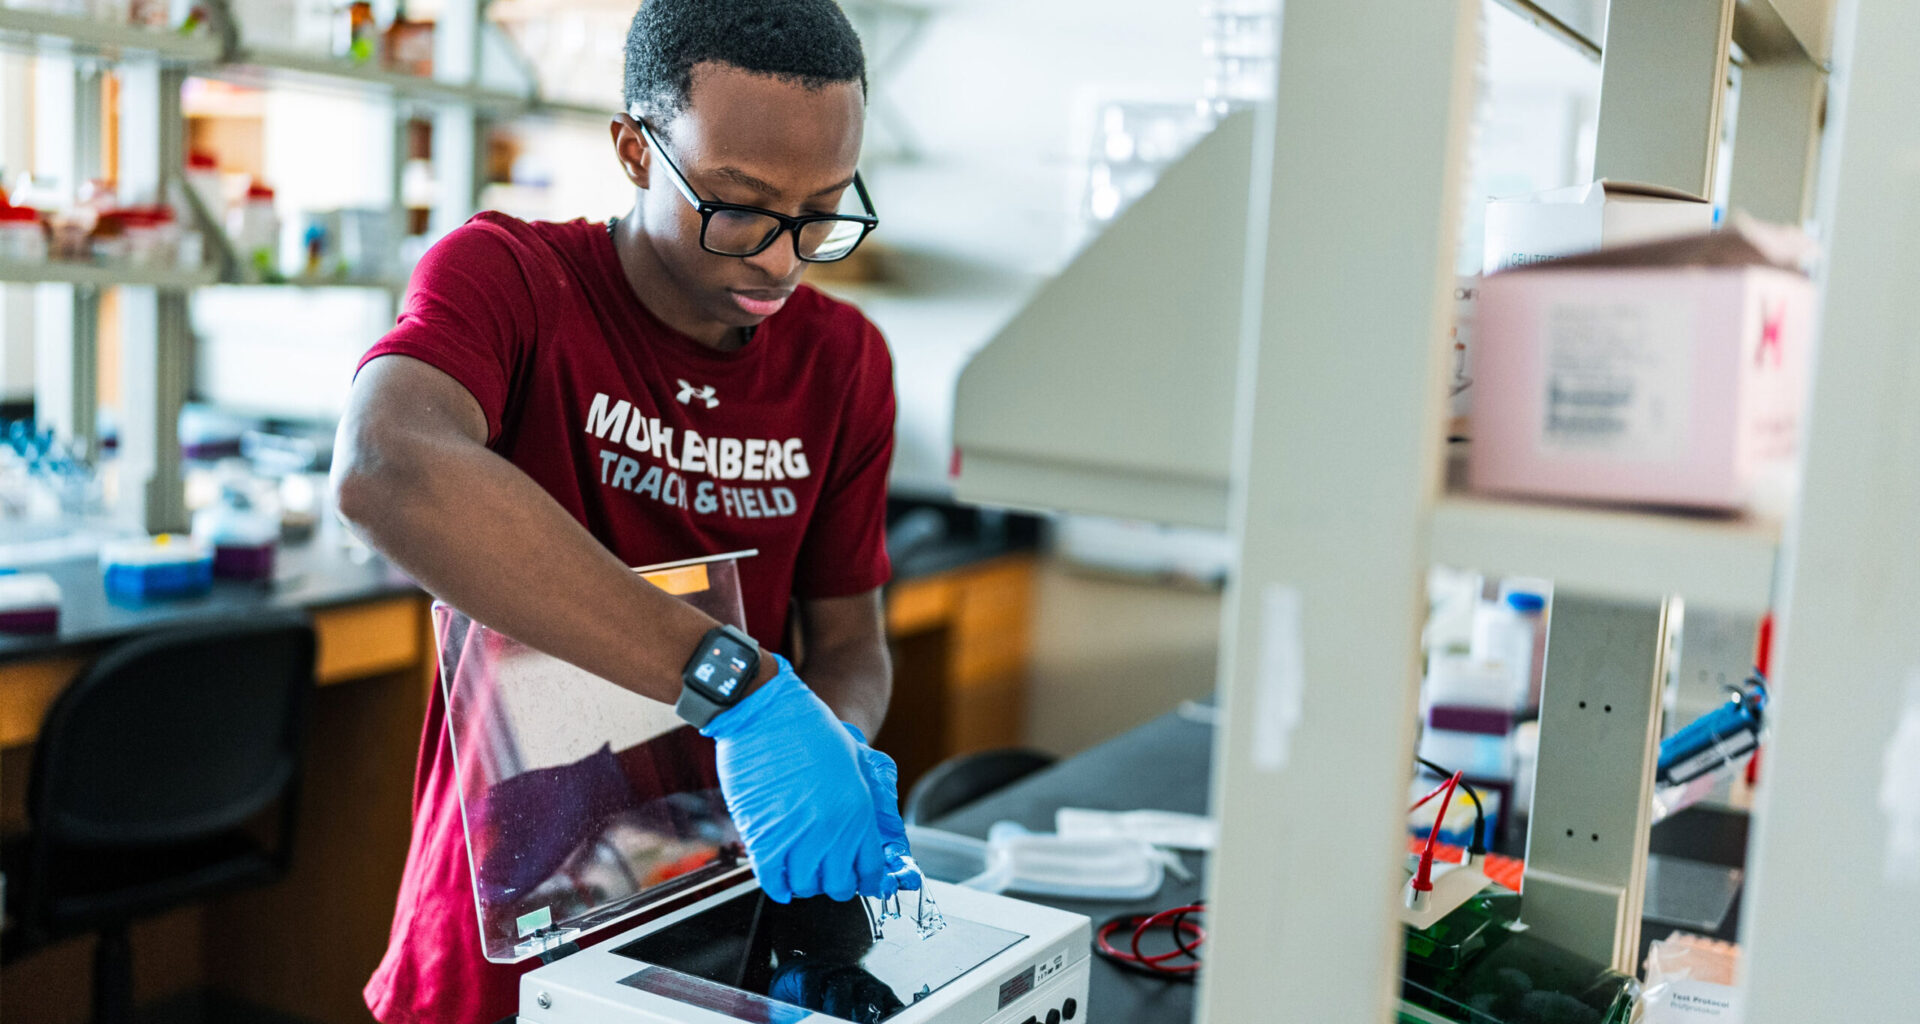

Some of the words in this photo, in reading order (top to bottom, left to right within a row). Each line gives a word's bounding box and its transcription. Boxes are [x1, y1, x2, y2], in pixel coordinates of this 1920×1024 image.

[584, 392, 811, 481] MUHLENBERG
[599, 449, 689, 511] TRACK
[694, 481, 719, 514] &
[720, 485, 798, 519] FIELD
[1673, 992, 1690, 1002] Test
